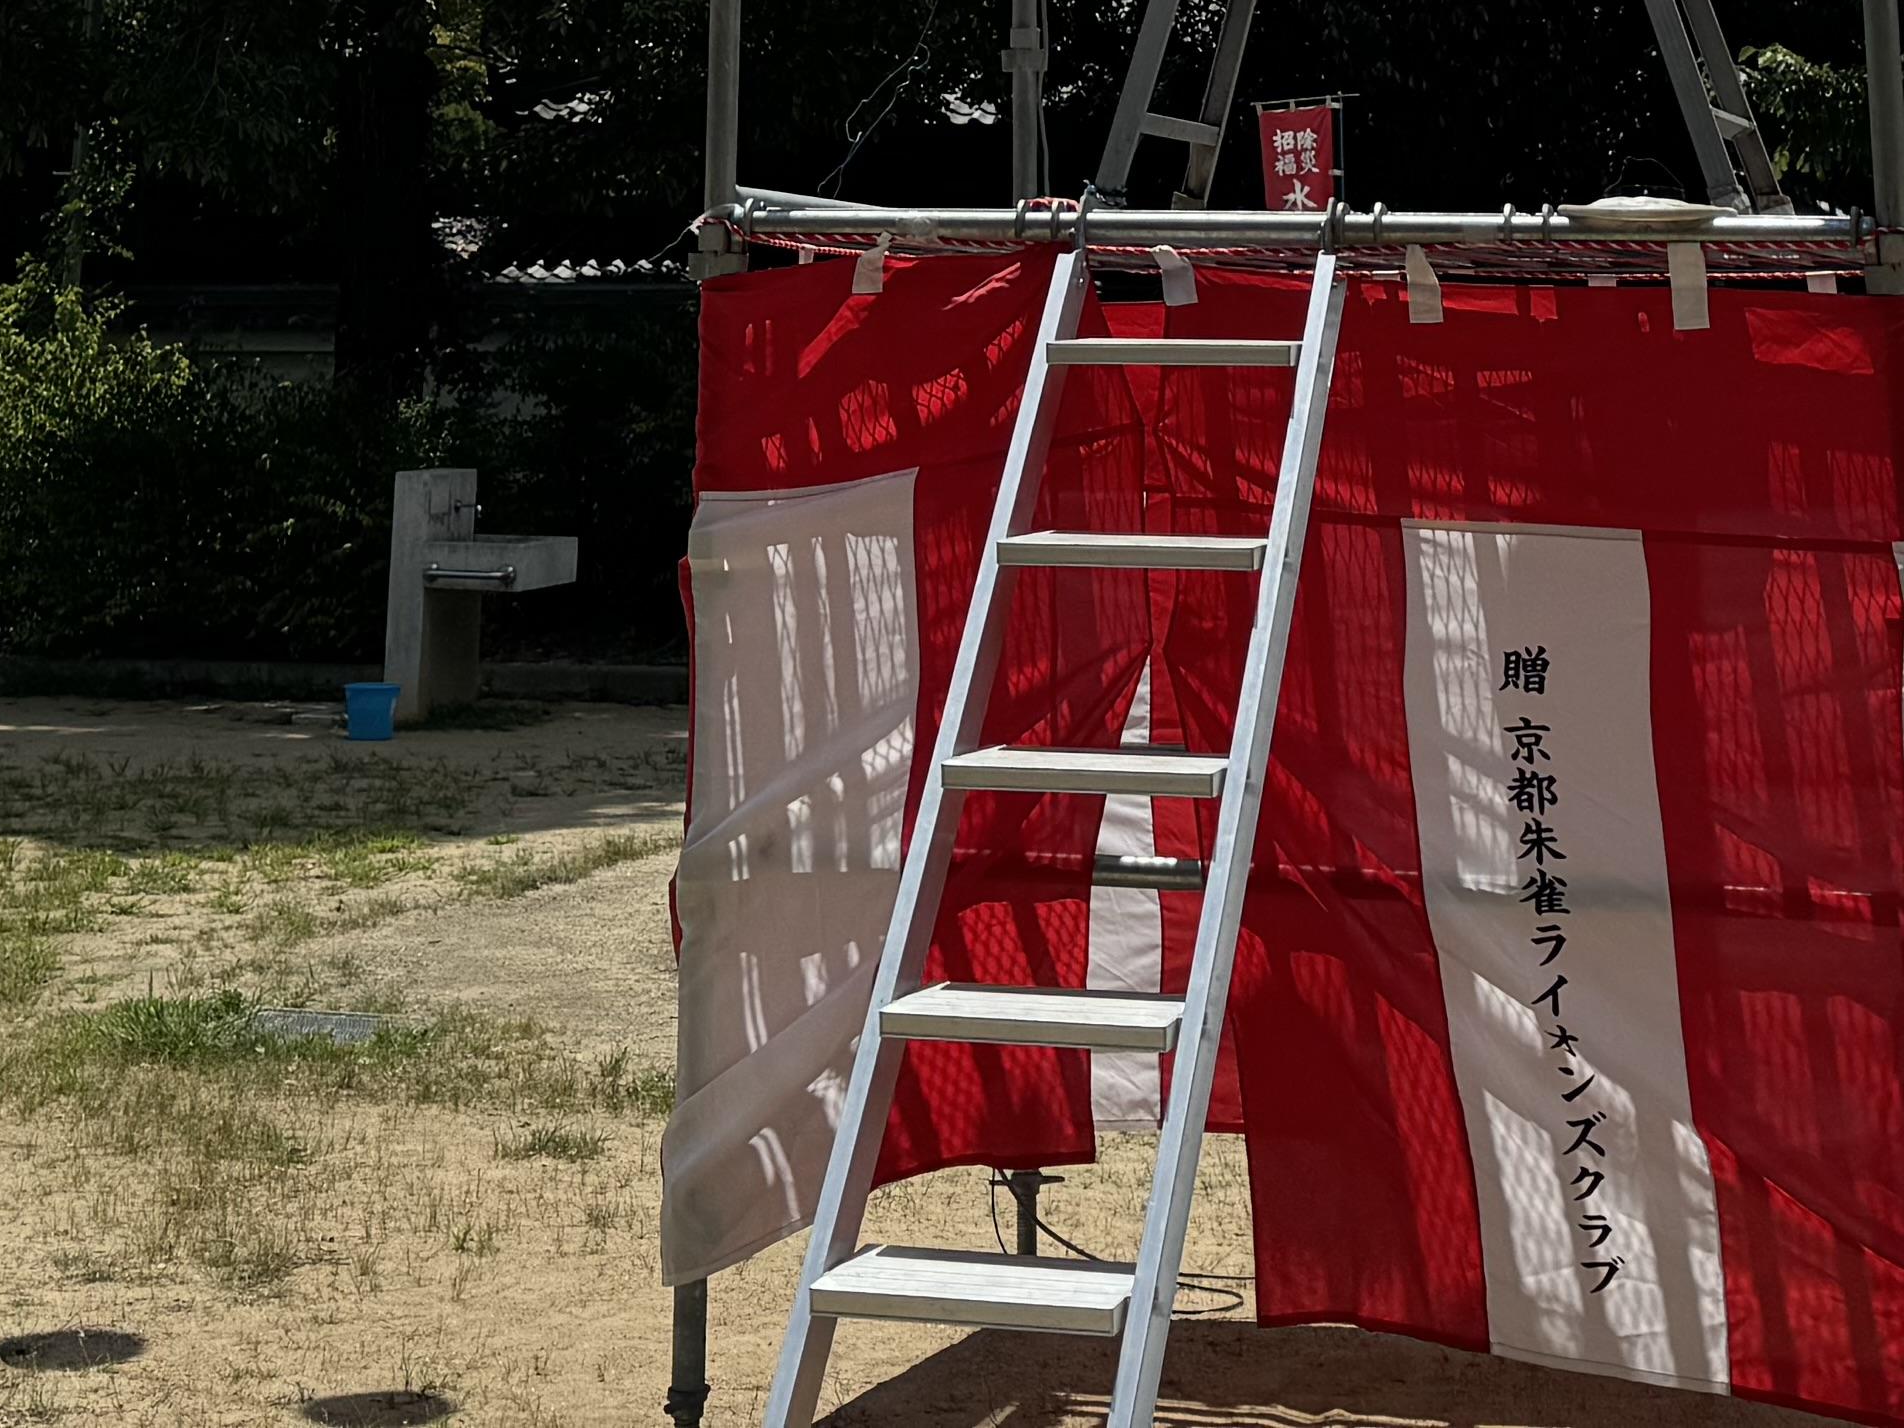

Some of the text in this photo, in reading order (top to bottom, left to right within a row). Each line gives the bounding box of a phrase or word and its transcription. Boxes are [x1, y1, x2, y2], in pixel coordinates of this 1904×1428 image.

[1272, 128, 1297, 176] 招福
[1296, 127, 1320, 175] 除災
[1498, 645, 1626, 1294] 贈 京都朱雀ライオンズクラブ
